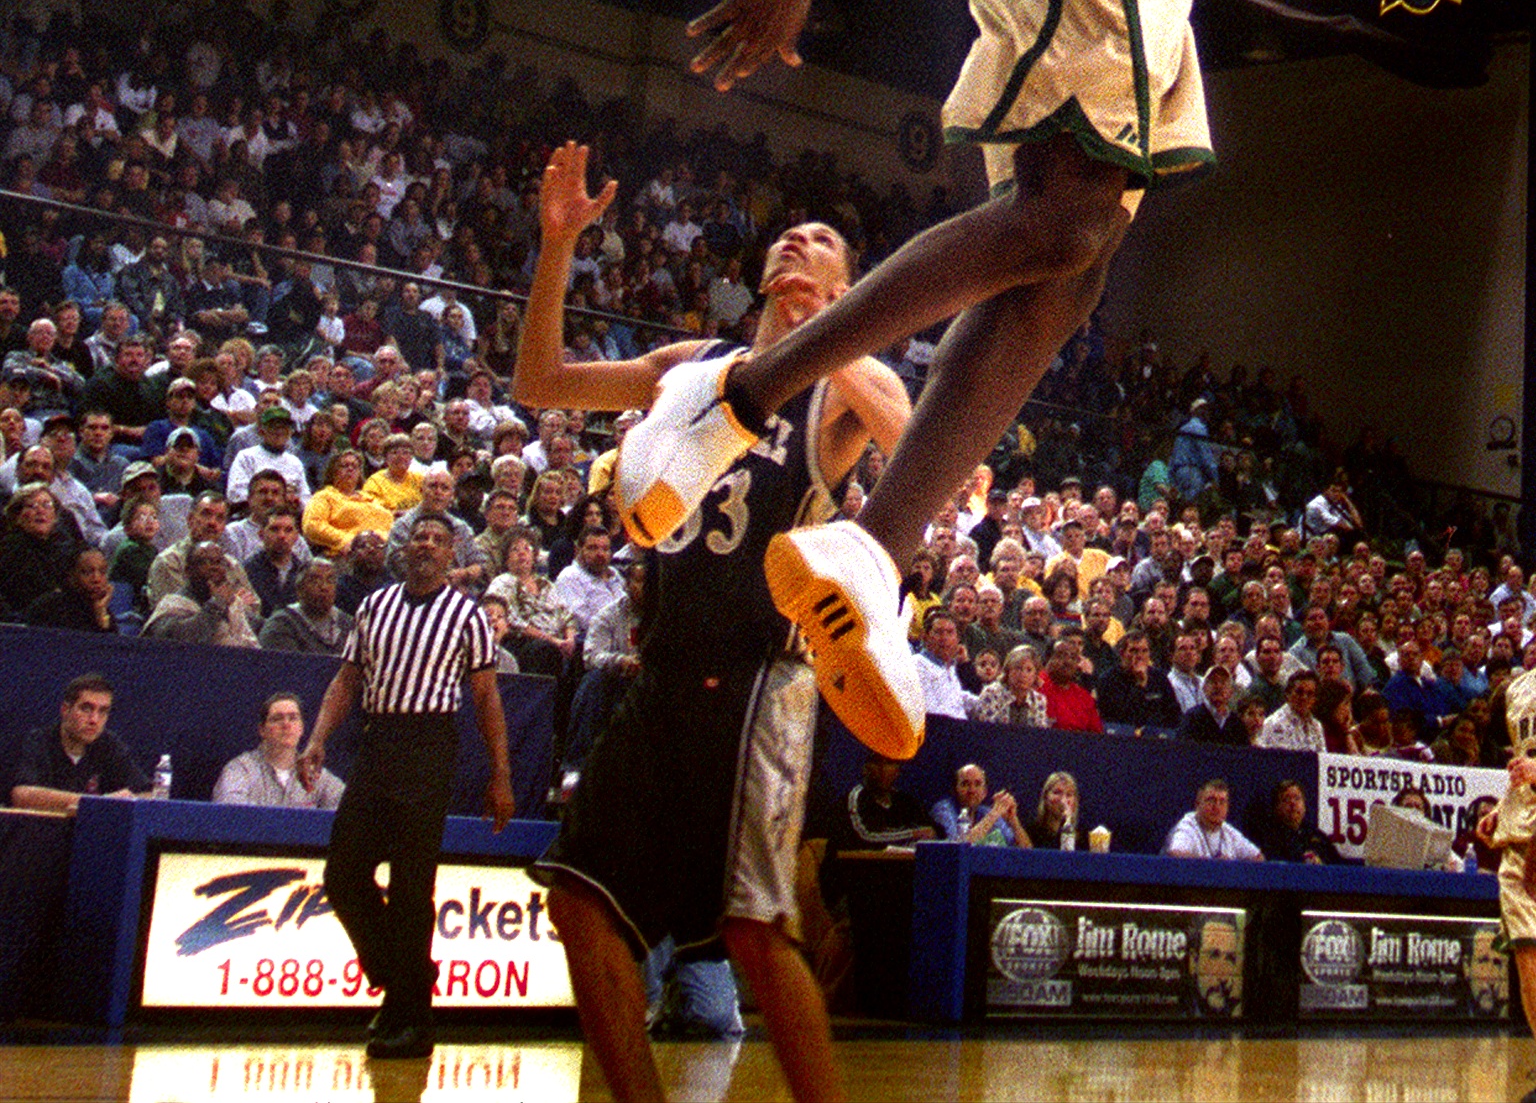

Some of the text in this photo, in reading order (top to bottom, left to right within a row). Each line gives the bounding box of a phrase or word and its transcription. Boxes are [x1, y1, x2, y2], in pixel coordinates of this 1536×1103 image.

[1327, 765, 1466, 797] SPORTSRADIO
[436, 886, 564, 942] cket
[1073, 915, 1188, 961] Jim Rome
[1367, 926, 1461, 966] Jim Rome
